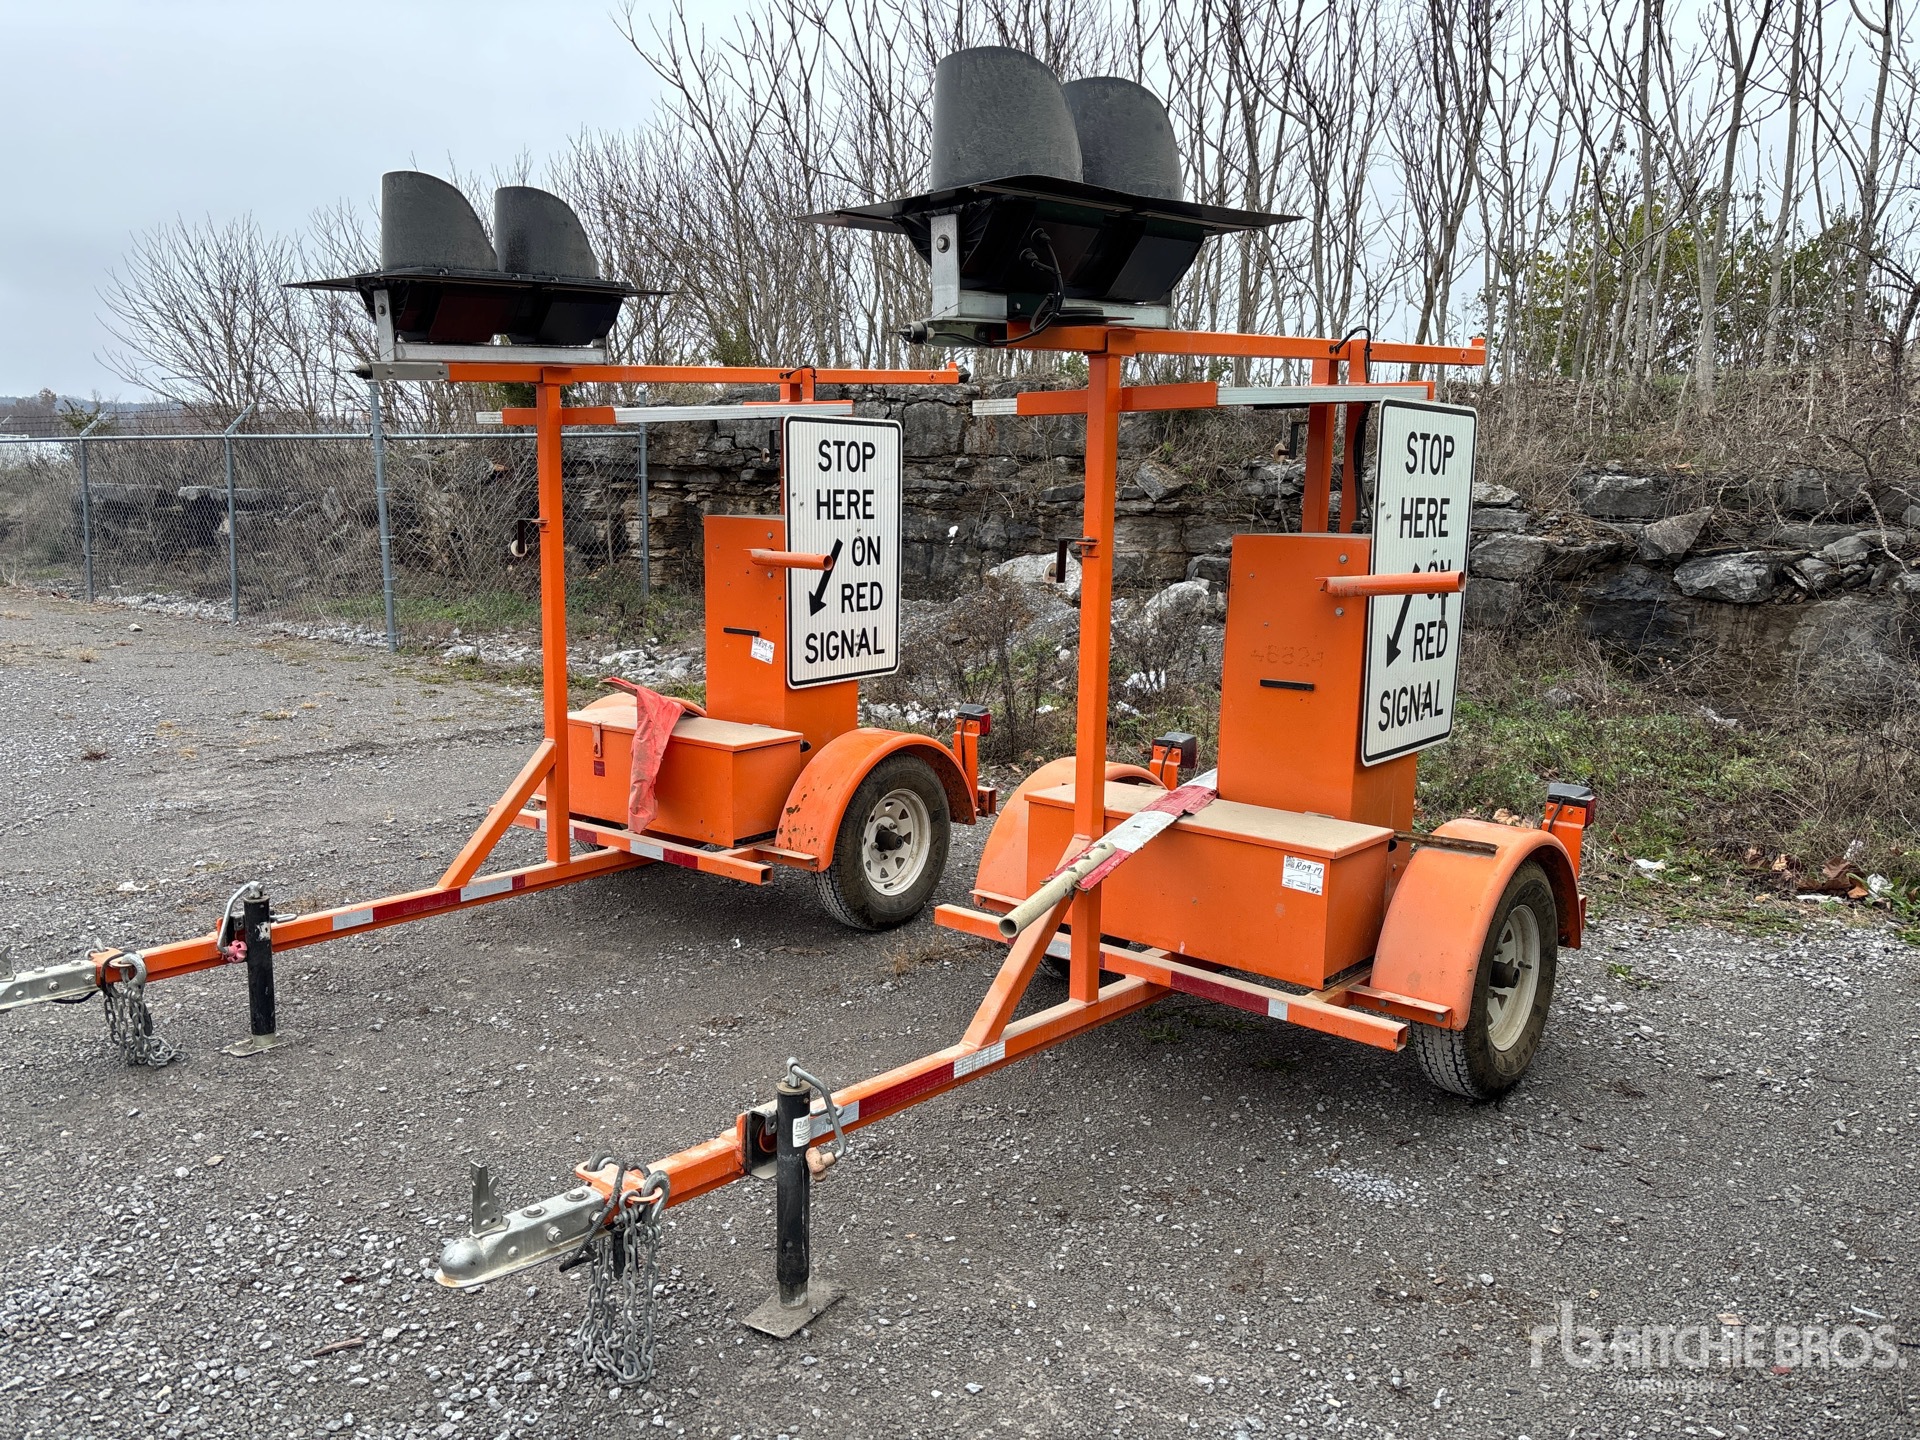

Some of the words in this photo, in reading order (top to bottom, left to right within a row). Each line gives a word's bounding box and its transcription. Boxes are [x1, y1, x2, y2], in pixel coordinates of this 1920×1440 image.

[818, 439, 876, 472] STOP
[1405, 431, 1455, 475] STOP
[816, 488, 875, 520] HERE
[1400, 497, 1450, 538] HERE
[852, 535, 881, 567] ON
[841, 581, 883, 614] RED
[805, 626, 885, 664] SIGNAL
[1412, 620, 1448, 663] RED
[1378, 679, 1444, 732] SIGNAL
